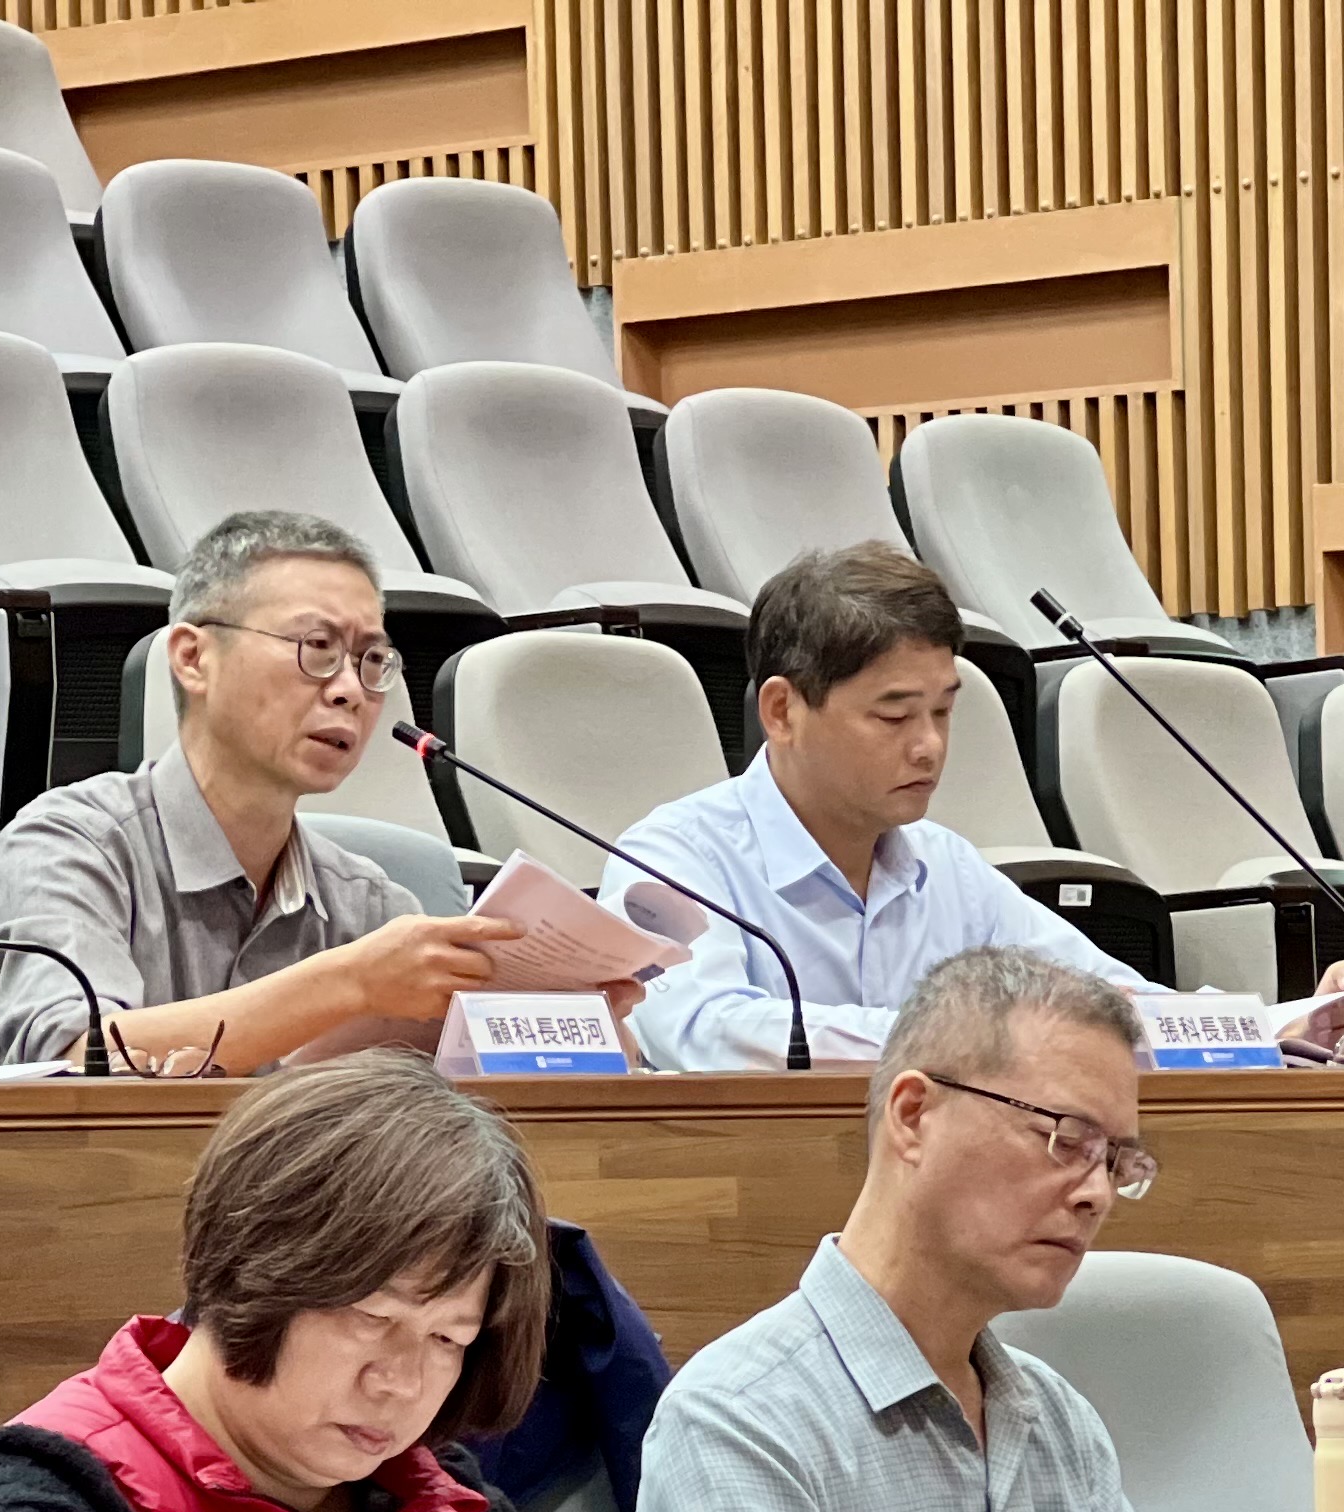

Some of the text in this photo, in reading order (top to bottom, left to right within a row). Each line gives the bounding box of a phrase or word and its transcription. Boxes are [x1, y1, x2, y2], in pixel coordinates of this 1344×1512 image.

[485, 1016, 607, 1046] 顧科長明河
